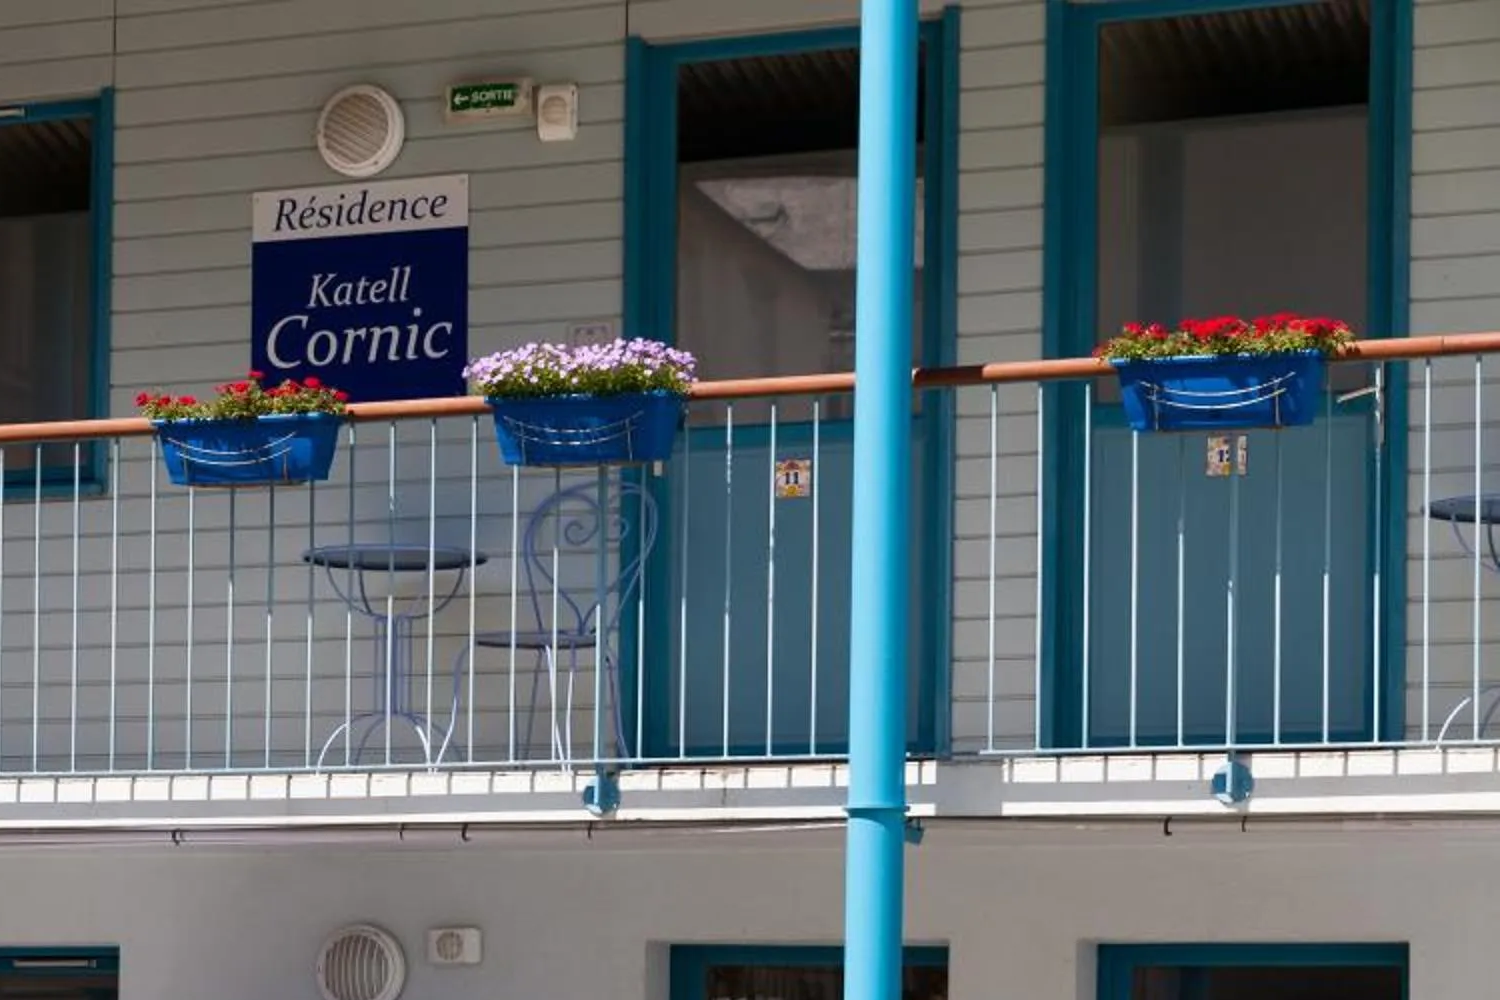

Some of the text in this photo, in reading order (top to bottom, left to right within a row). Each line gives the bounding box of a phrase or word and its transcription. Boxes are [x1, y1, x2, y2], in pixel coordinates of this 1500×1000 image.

[274, 189, 448, 232] Résidence
[306, 265, 411, 309] Katell
[265, 307, 453, 369] Cornic
[785, 471, 799, 485] 11
